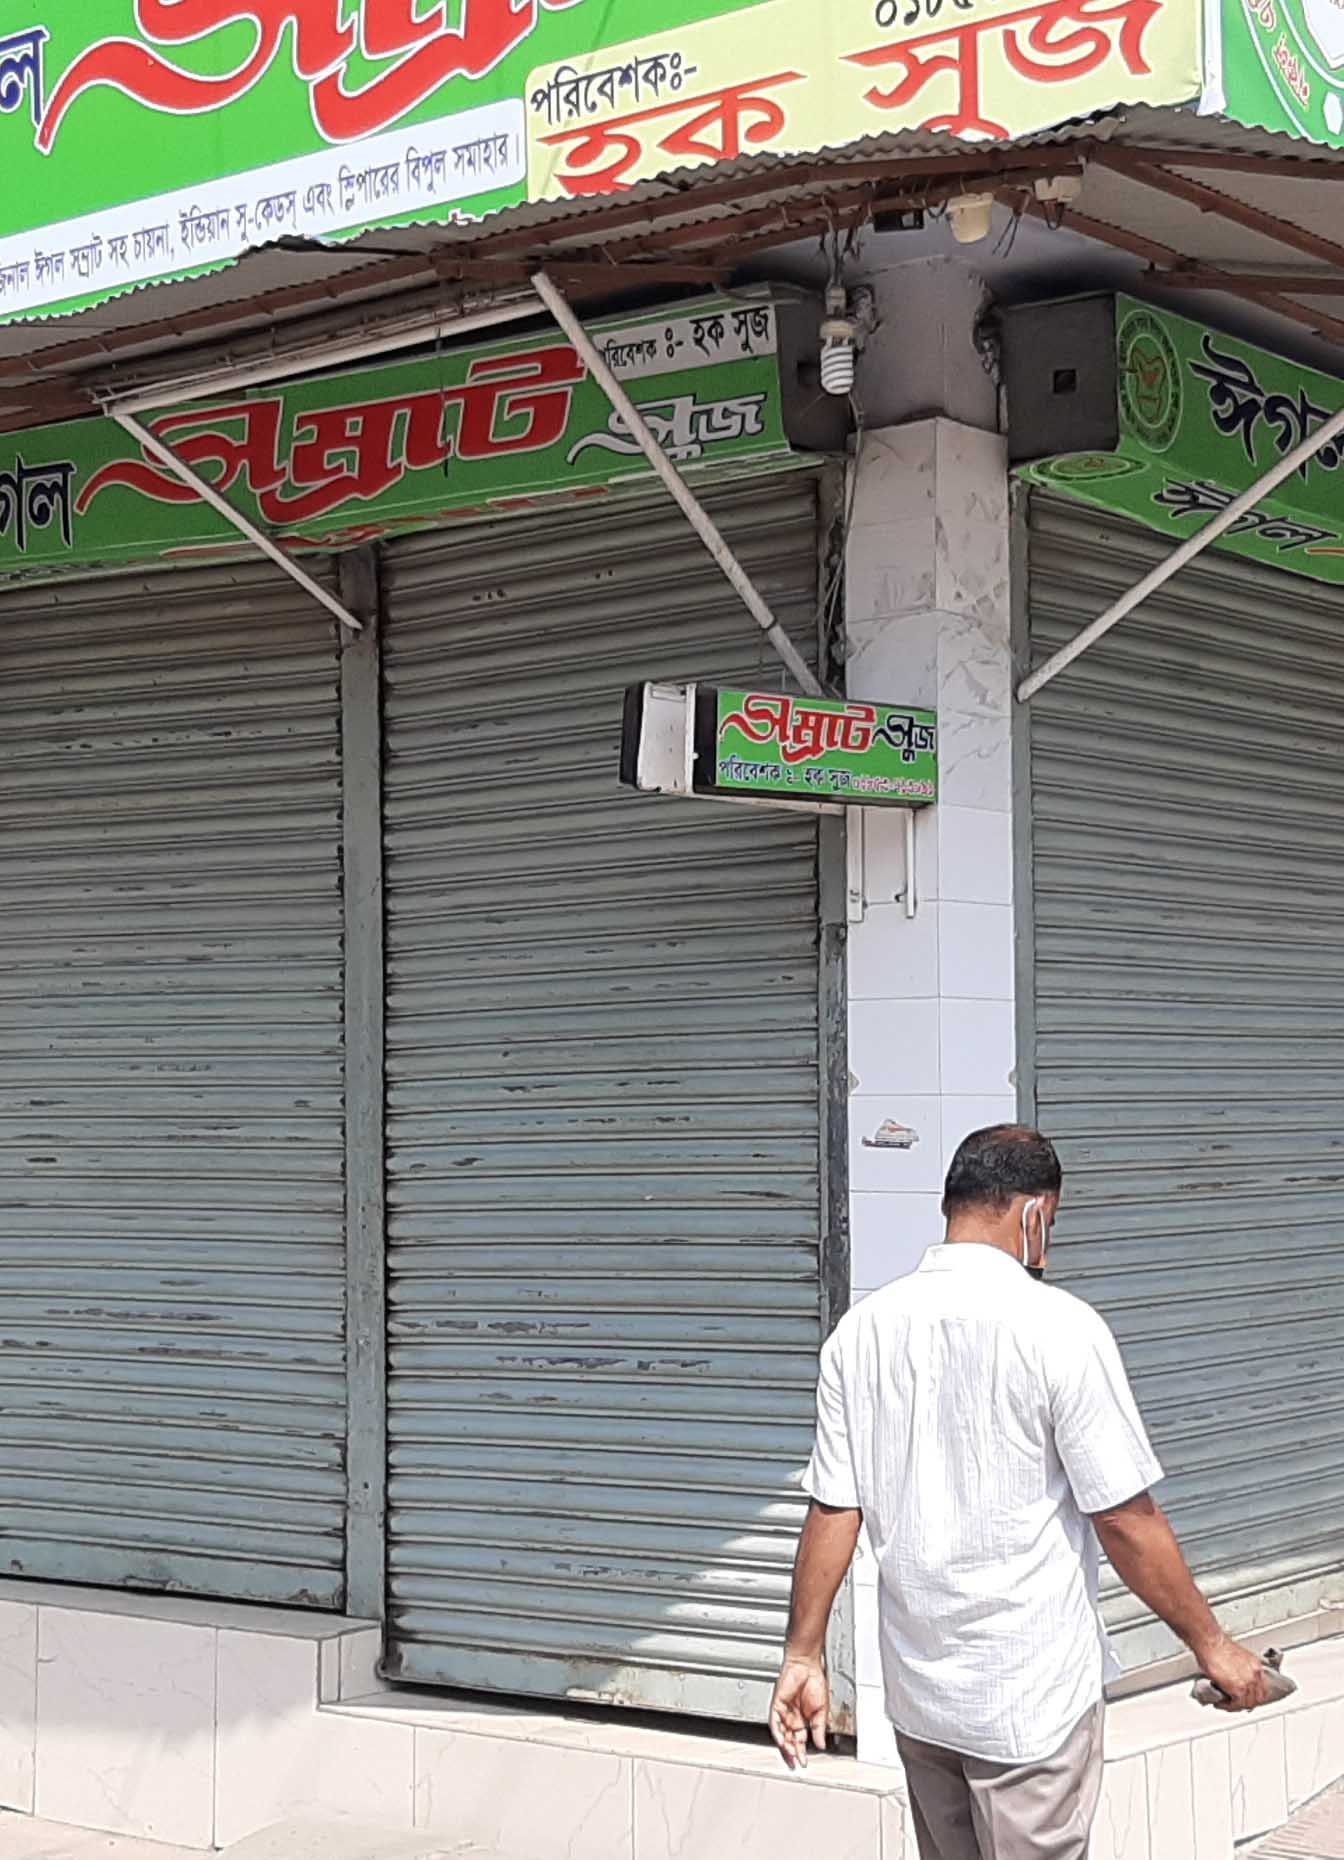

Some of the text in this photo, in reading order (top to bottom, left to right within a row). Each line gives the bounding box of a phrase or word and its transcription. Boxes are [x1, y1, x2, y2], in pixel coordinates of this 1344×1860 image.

[536, 70, 809, 195] হক
[839, 0, 1164, 139] সুজ
[33, 249, 66, 287] ঈগল
[107, 234, 129, 269] সহ
[178, 204, 230, 251] ইন্ডিয়ান
[303, 183, 334, 216] এবং
[406, 146, 446, 194] বিপুল
[689, 313, 725, 356] হক
[731, 305, 769, 354] সুজ
[74, 344, 588, 524] সম্রাট
[718, 694, 936, 763] সম্রাট সুজ
